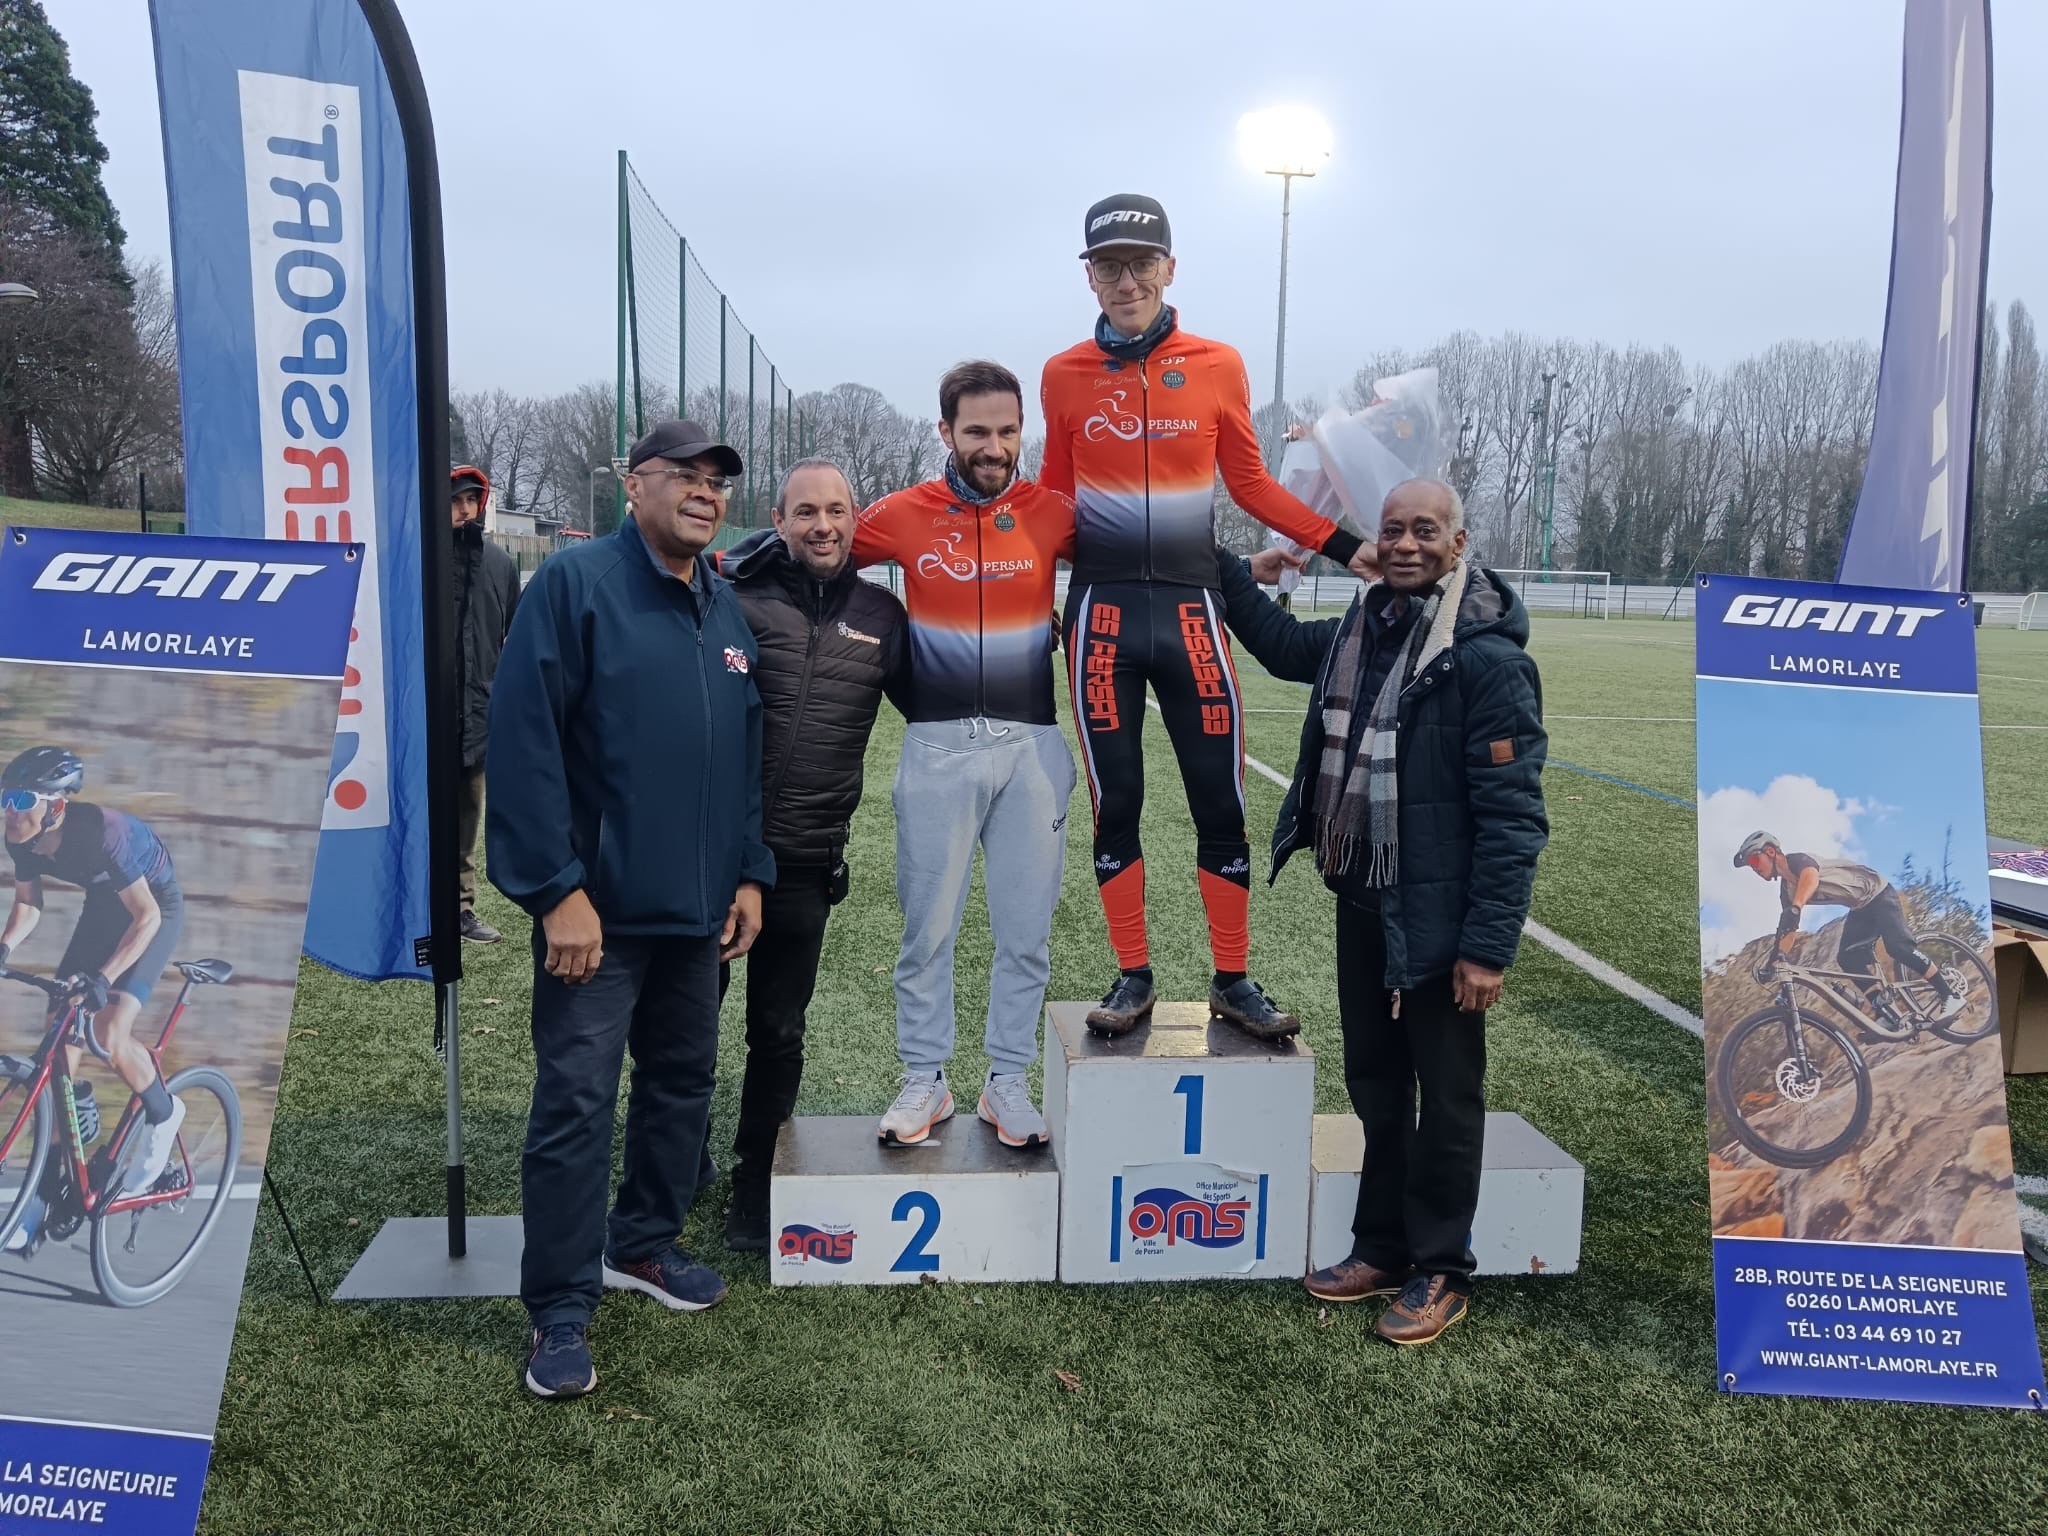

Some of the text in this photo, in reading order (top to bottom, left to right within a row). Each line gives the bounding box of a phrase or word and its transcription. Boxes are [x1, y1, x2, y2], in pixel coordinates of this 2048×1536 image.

[1090, 210, 1159, 233] GIANT
[1120, 419, 1198, 431] ES PERSAN
[33, 552, 327, 602] GIANT
[954, 559, 1033, 572] ES PERSAN
[1722, 594, 1945, 637] GIANT
[83, 629, 254, 658] LAMORLAYE
[1086, 603, 1121, 732] ES PERSAN
[1178, 602, 1230, 735] ES PERSAN
[1770, 654, 1901, 679] LAMORLAYE
[1173, 1075, 1204, 1155] 1
[1202, 1191, 1231, 1203] des Sports
[889, 1190, 941, 1273] 2
[1135, 1247, 1164, 1255] de Persan
[1735, 1268, 2007, 1297] 28B, ROUTE DE LA SEIGNEURIE
[1785, 1293, 1958, 1316] 60260 LAMORLAYE
[1834, 1324, 1857, 1340] 03
[1861, 1325, 1885, 1341] 44
[1890, 1327, 1912, 1343] 69
[1916, 1328, 1936, 1345] 10
[1941, 1330, 1962, 1346] 27
[1761, 1350, 1998, 1378] WWW.GIANT-LAMORLAYE.FR
[4, 1461, 178, 1498] LA SEIGNEURIE
